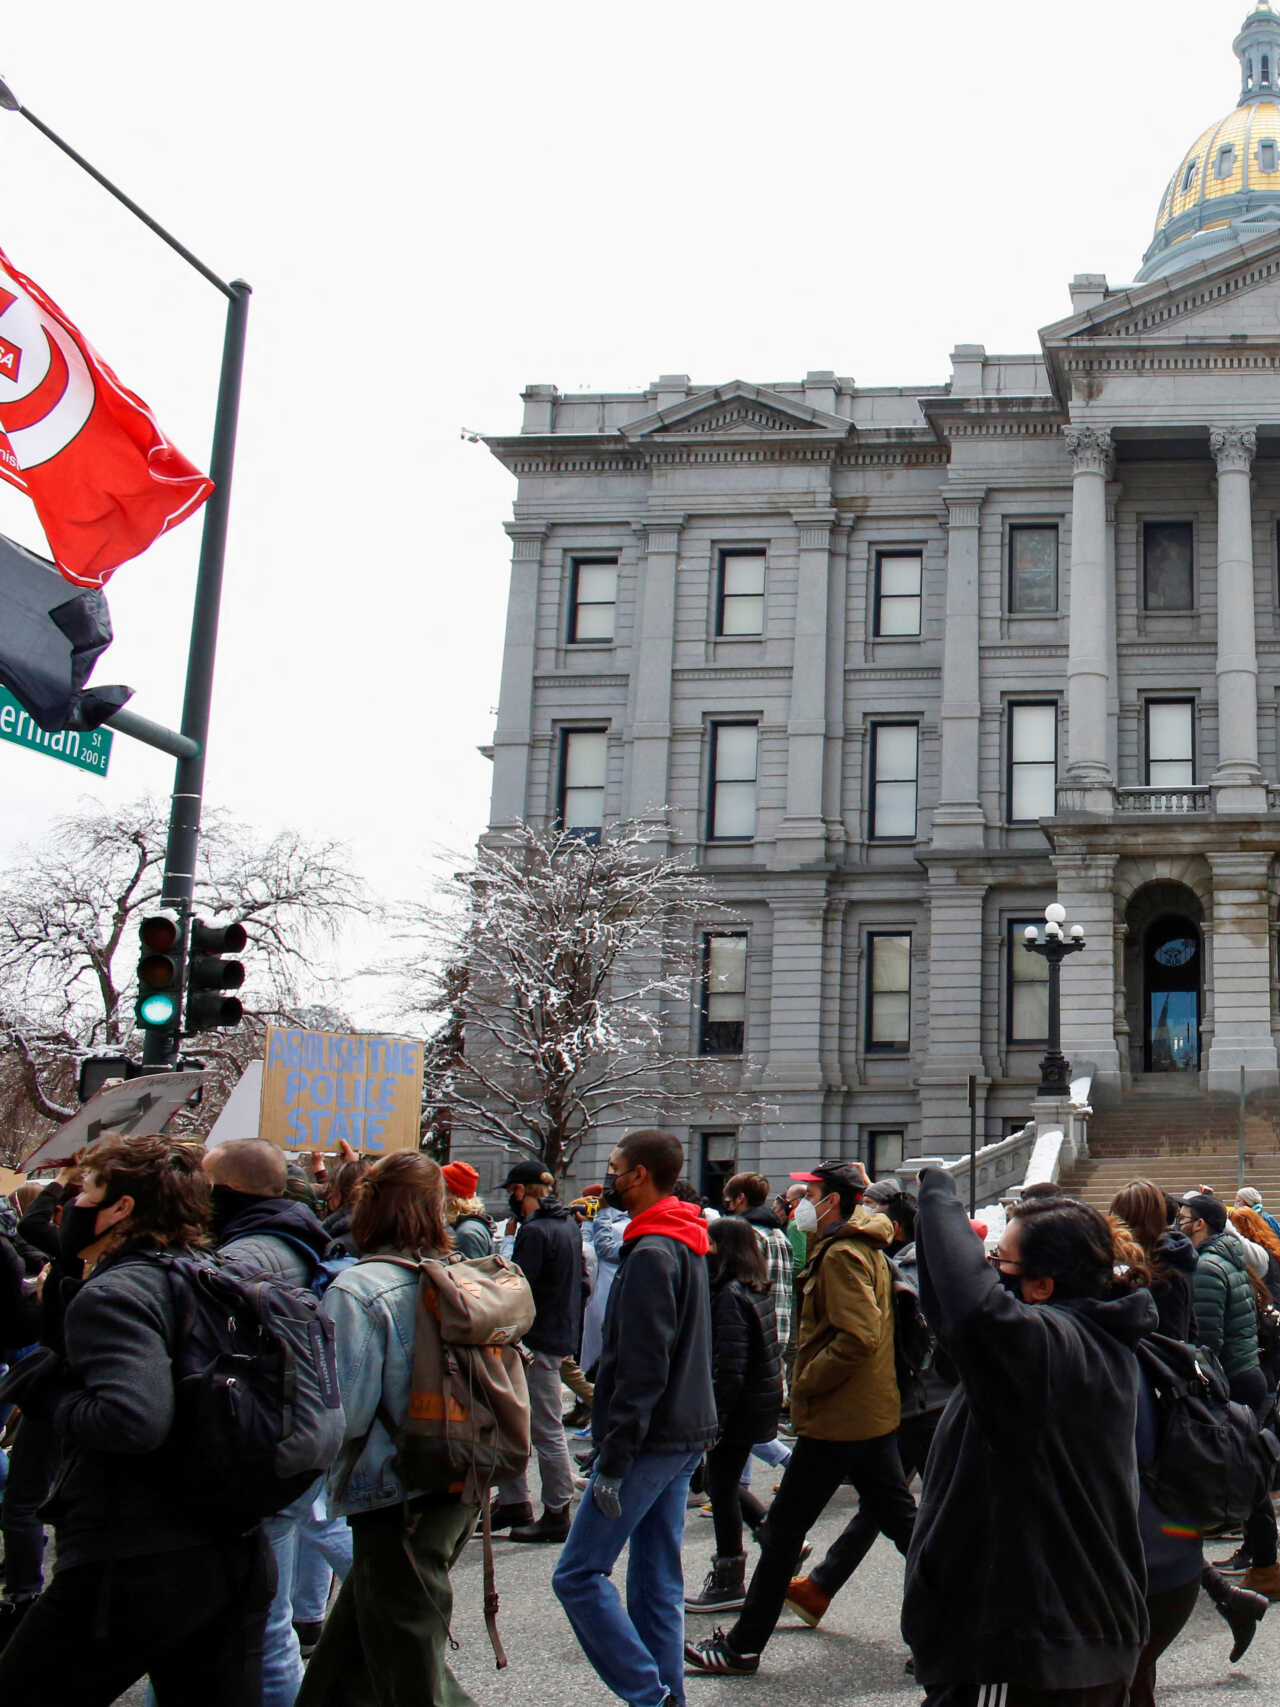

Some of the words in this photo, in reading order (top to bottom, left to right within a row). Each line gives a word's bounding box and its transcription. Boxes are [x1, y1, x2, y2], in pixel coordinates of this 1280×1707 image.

[80, 748, 98, 766] 200
[100, 756, 106, 769] E
[92, 733, 101, 748] St
[269, 1029, 365, 1075] ABOLISH
[368, 1039, 418, 1076] THE
[284, 1070, 398, 1113] POLICE
[285, 1107, 390, 1150] STATE
